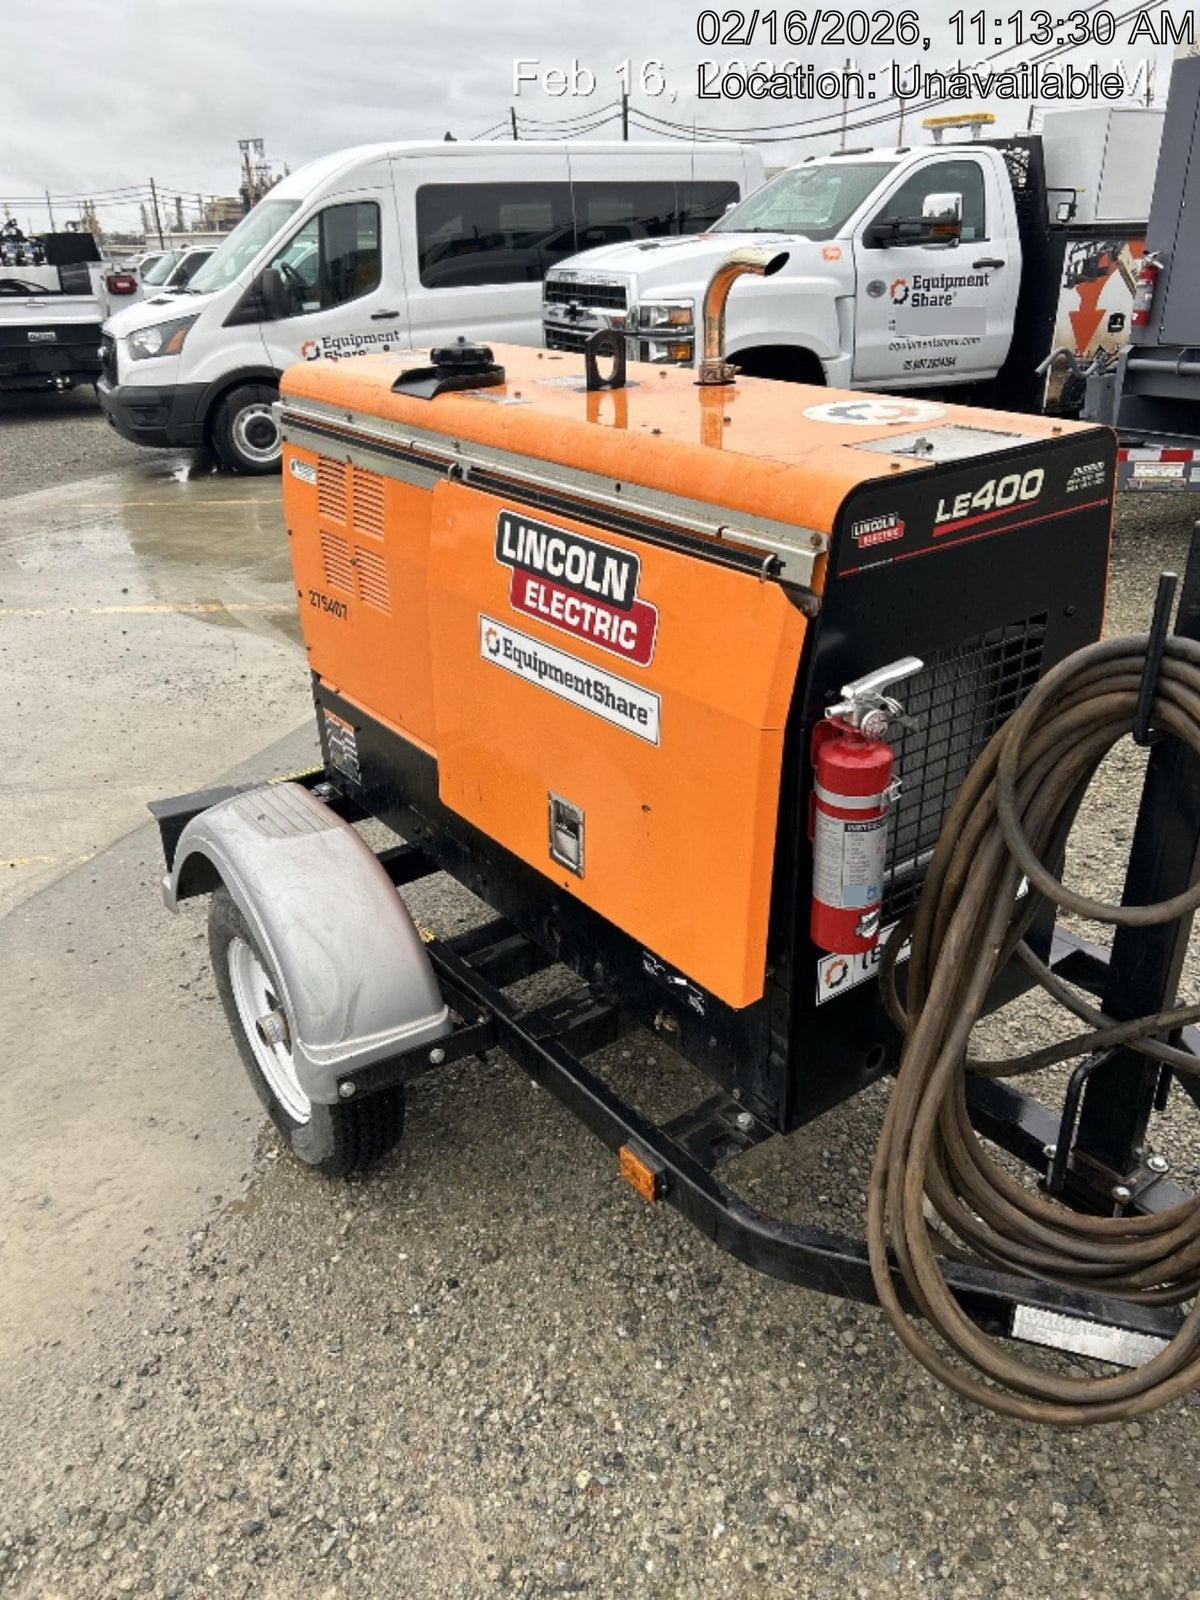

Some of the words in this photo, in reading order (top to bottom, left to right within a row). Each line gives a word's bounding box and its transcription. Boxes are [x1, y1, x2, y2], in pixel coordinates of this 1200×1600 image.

[911, 272, 991, 292] Equipment
[911, 292, 953, 308] Share
[321, 329, 400, 350] Equipment
[934, 467, 1045, 524] LE400
[854, 516, 896, 536] LINCOLN
[501, 520, 630, 602] LINCOLN
[524, 578, 638, 650] ELECTRIC
[502, 637, 650, 726] EquipmentShare
